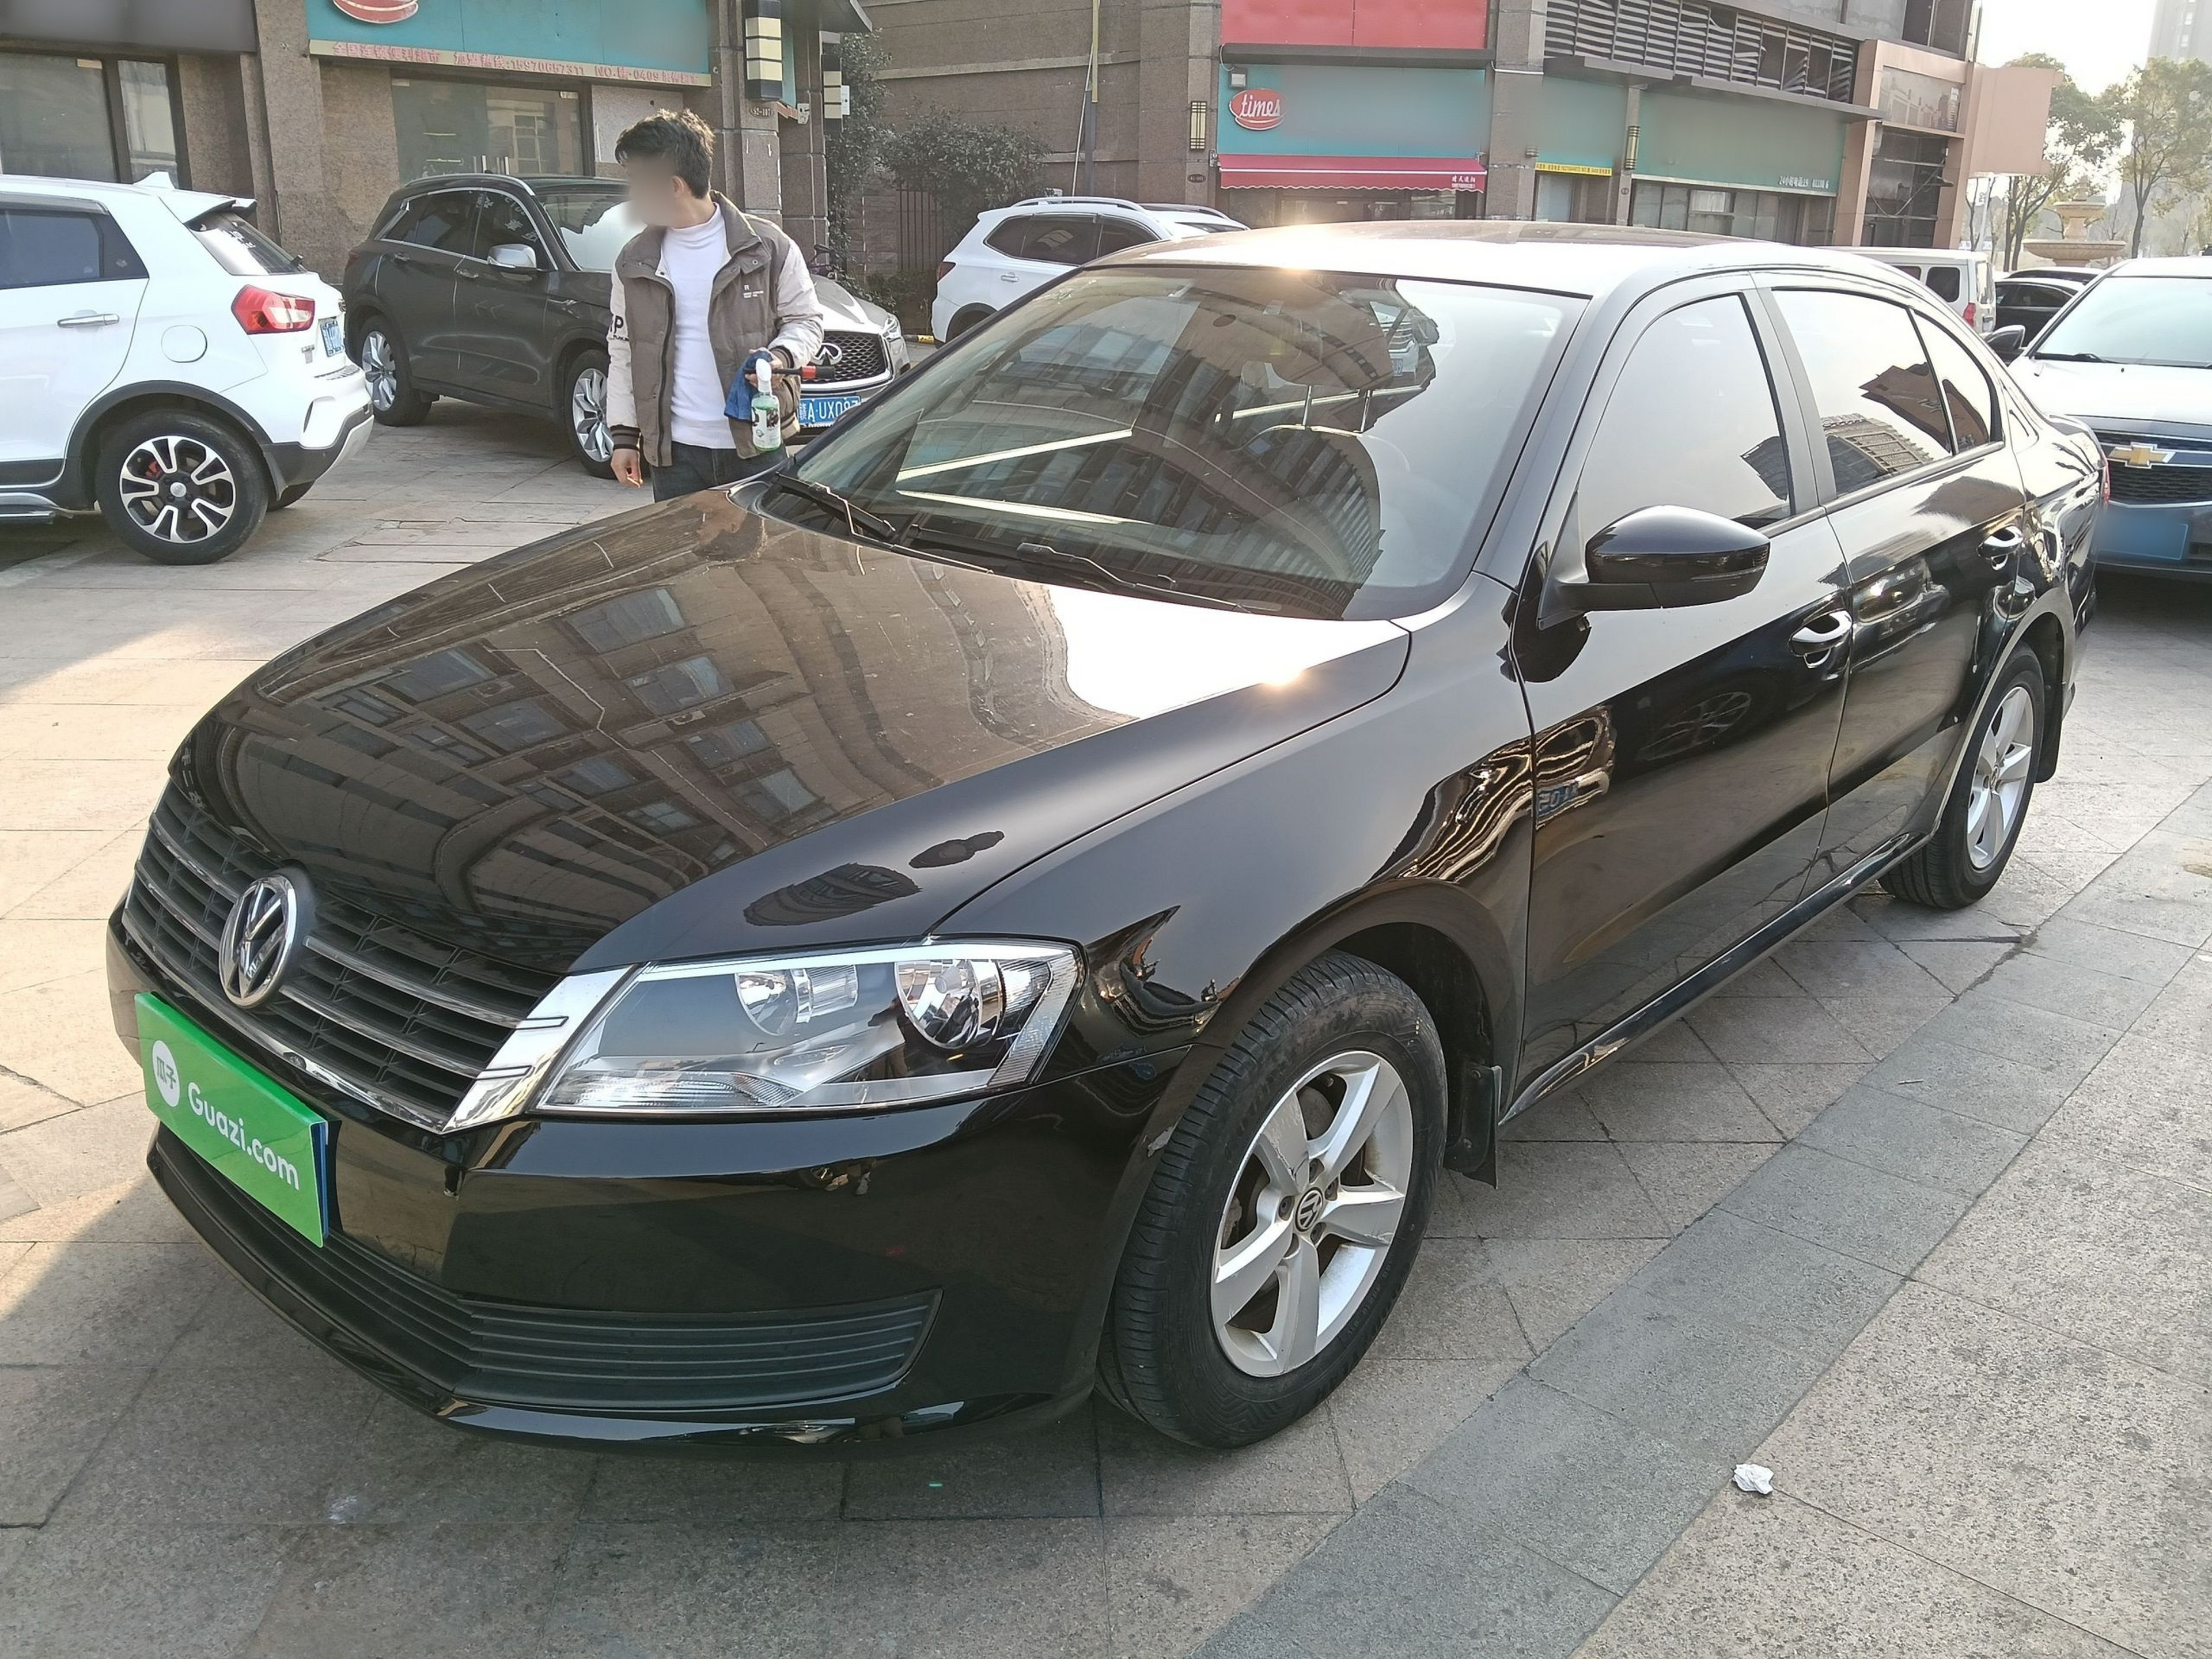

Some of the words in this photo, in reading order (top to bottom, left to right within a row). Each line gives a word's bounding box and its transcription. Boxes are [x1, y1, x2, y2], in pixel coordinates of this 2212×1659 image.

[1239, 94, 1280, 117] times
[157, 1056, 176, 1089] 瓜子
[188, 1082, 300, 1191] Guazi.com
